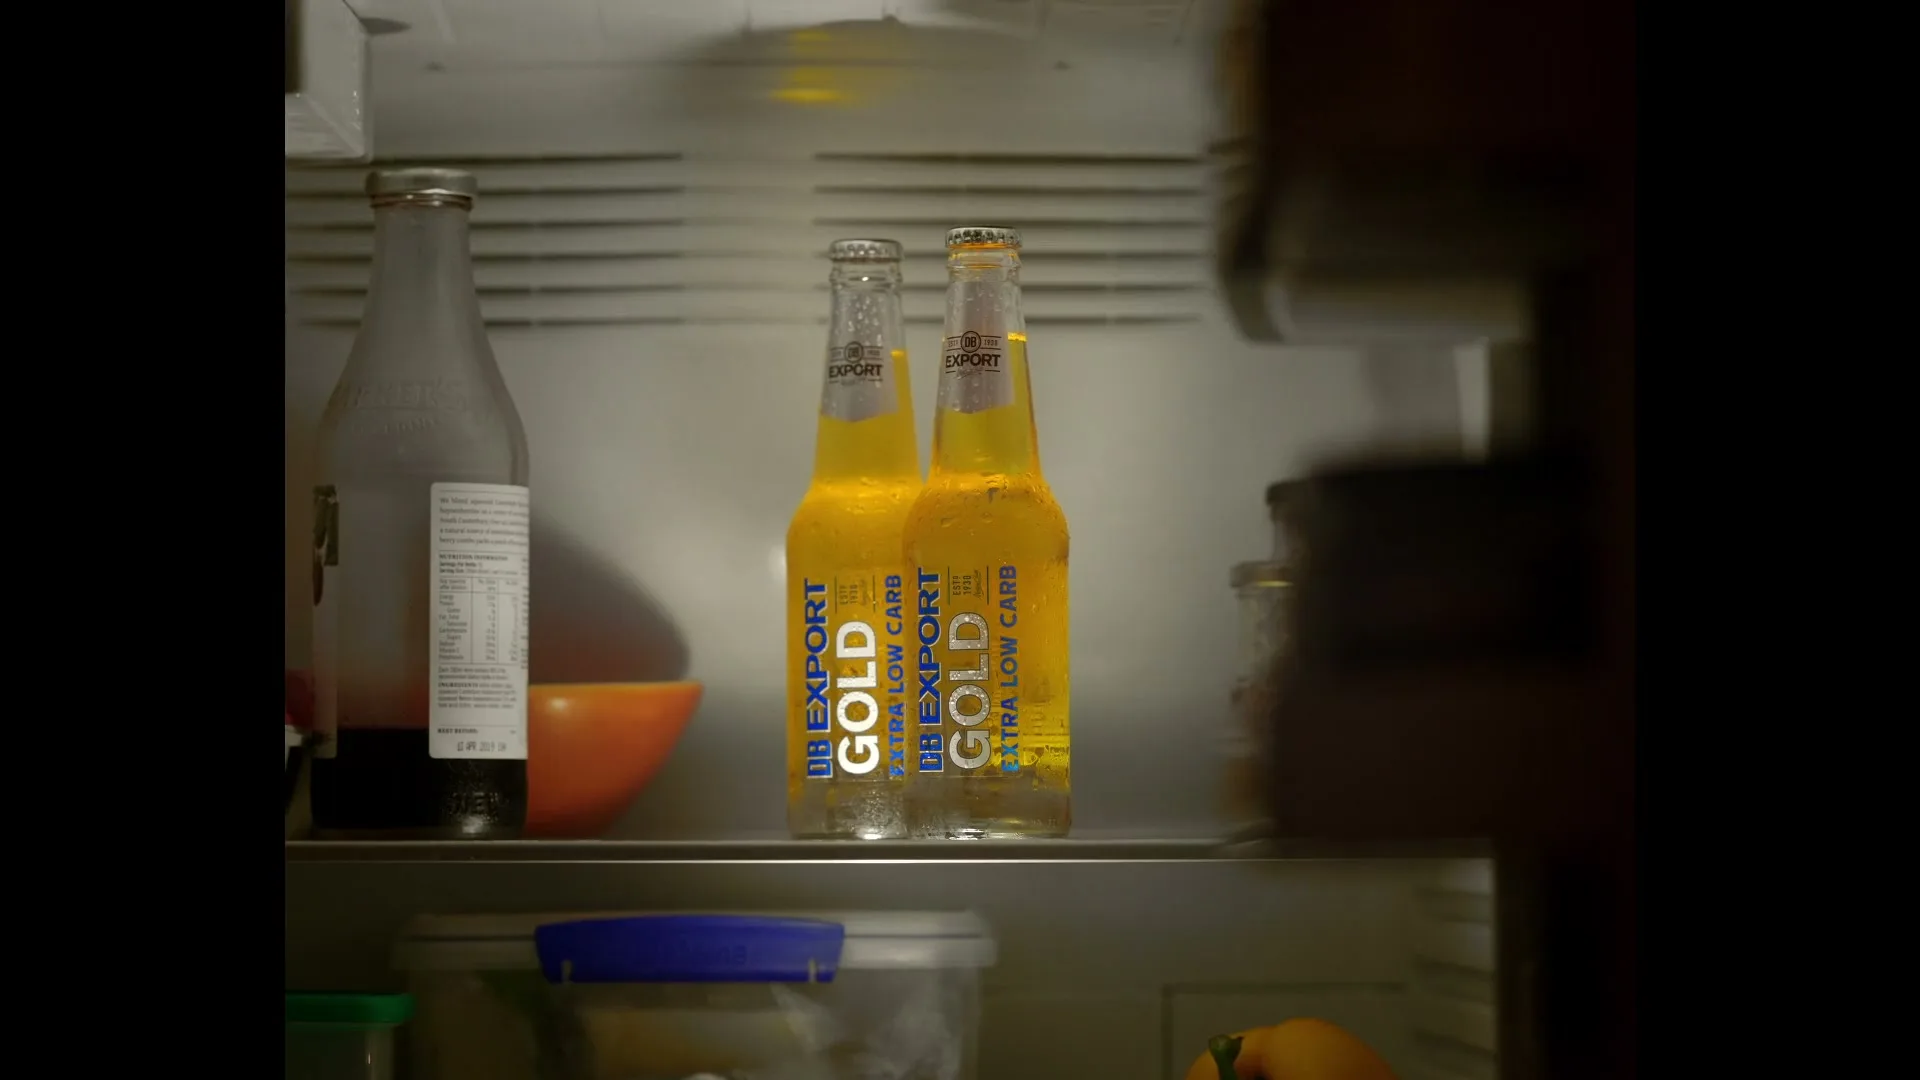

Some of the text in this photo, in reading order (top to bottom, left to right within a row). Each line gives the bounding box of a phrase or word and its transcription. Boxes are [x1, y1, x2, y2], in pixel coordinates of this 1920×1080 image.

[828, 363, 884, 378] EXPORT
[944, 353, 1002, 369] EXPORT
[964, 336, 977, 348] DB
[962, 574, 973, 596] 1930
[804, 577, 833, 779] DB EXPORT
[836, 621, 880, 775] GOLD
[885, 574, 905, 779] EXTRA LOW CARB
[918, 566, 944, 773] DB EXPORT
[948, 611, 991, 769] GOLD
[999, 564, 1019, 773] EXTRA LOW CARB
